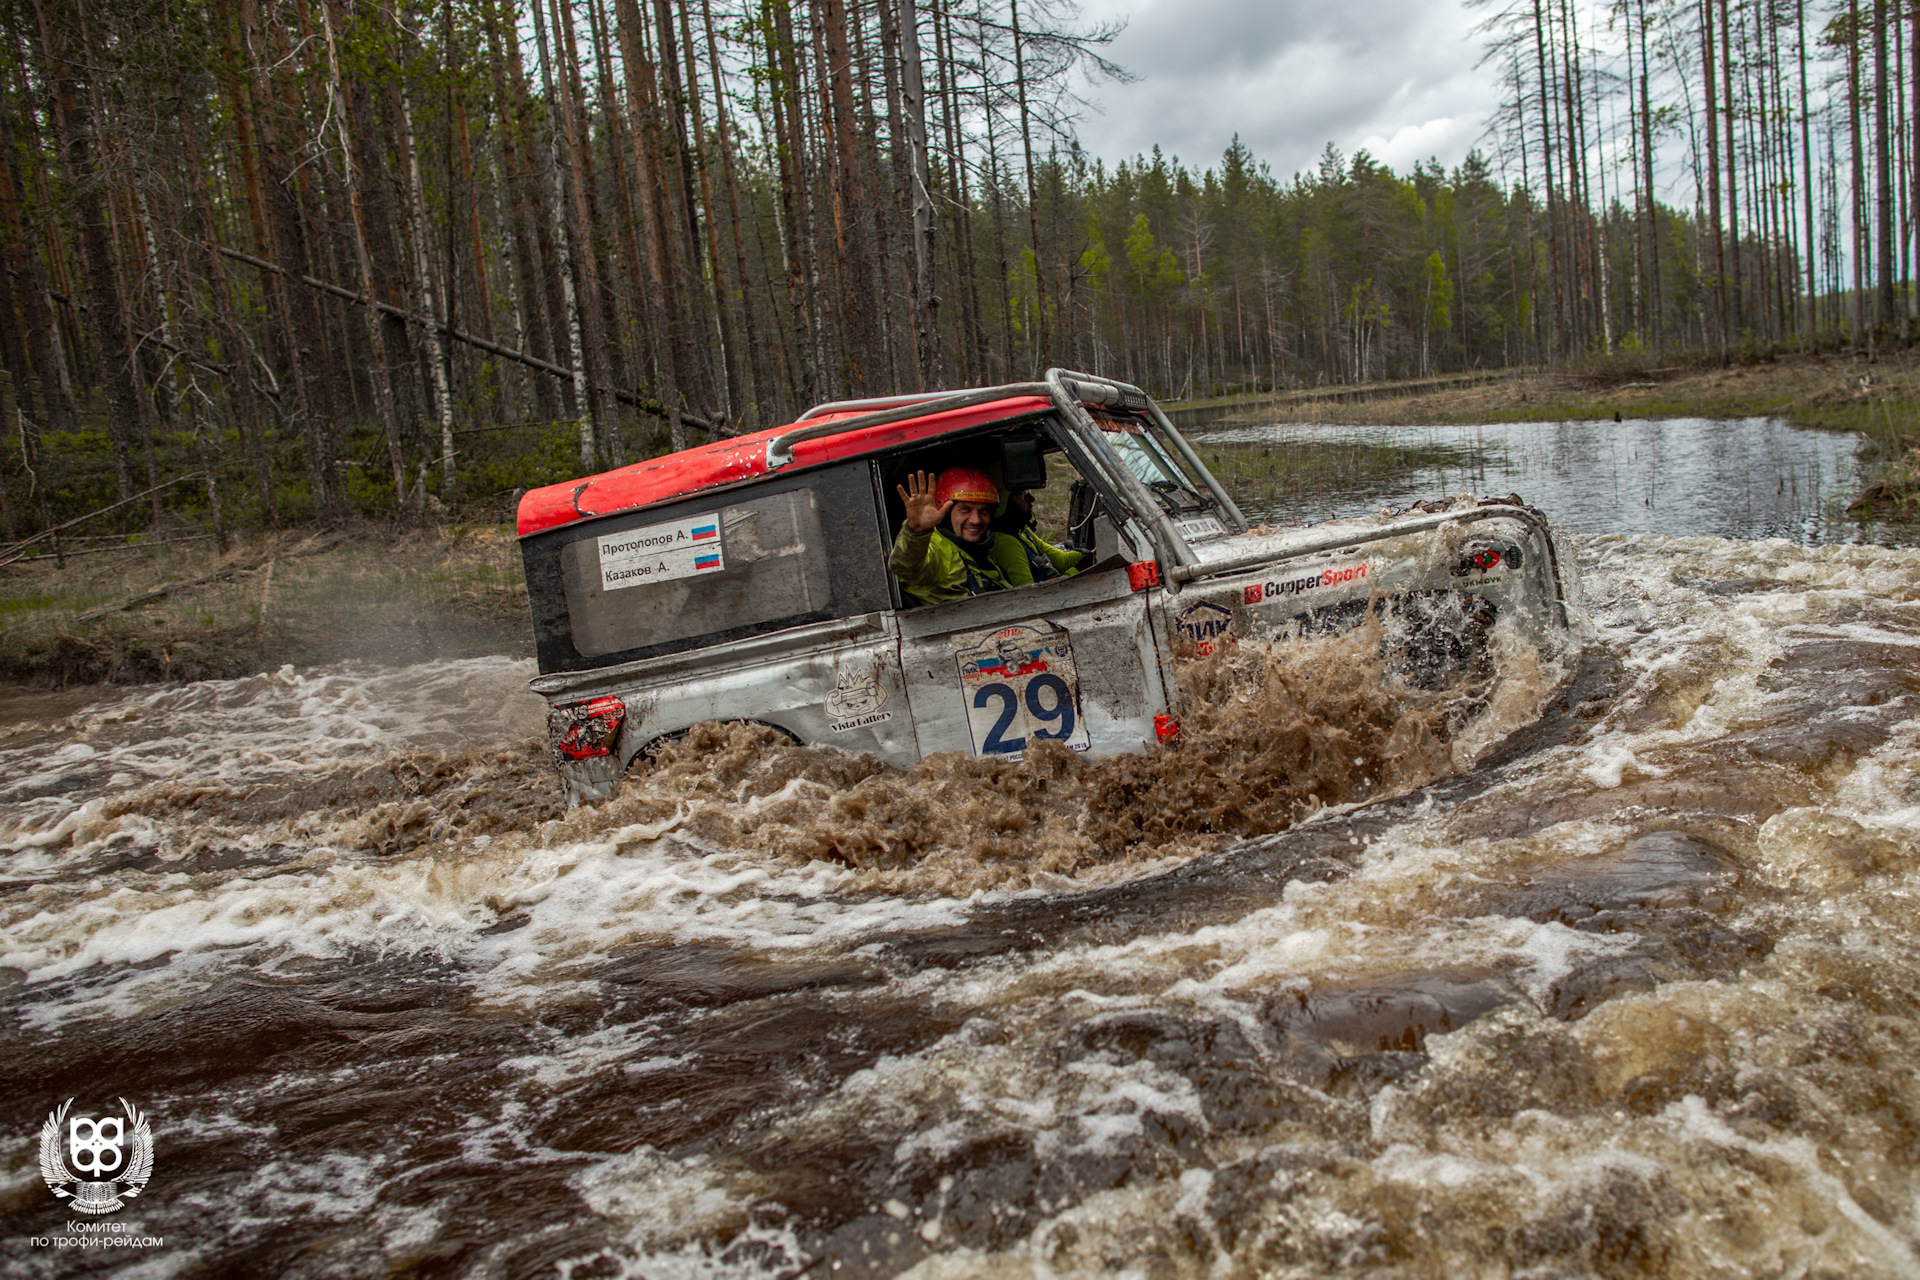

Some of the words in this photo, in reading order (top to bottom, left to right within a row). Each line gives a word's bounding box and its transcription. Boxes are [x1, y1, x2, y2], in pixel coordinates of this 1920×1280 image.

[602, 534, 673, 556] Протопопов
[676, 529, 688, 541] А.
[605, 566, 652, 582] Казаков
[658, 561, 670, 573] А.
[1264, 563, 1368, 597] CupperSport
[996, 628, 1022, 640] 2019
[962, 663, 979, 675] ПИК
[973, 673, 1075, 755] 29
[831, 721, 857, 732] Vista
